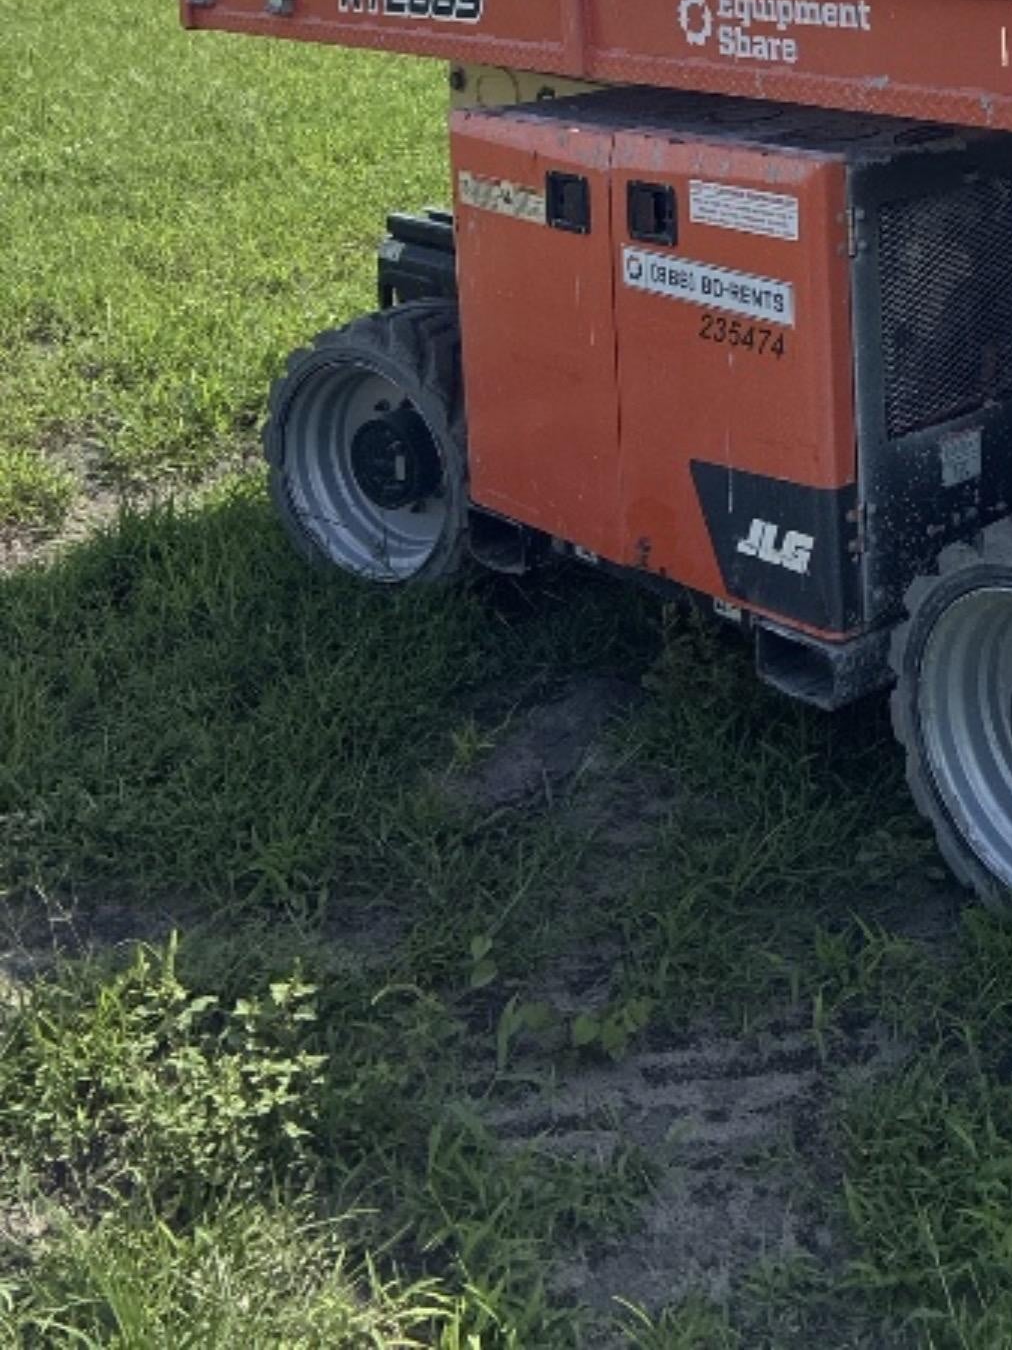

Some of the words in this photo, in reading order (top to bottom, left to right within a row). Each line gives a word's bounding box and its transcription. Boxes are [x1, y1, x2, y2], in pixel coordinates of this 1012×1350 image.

[719, 24, 799, 64] Share
[699, 314, 785, 359] 235474
[737, 517, 814, 575] JLG
